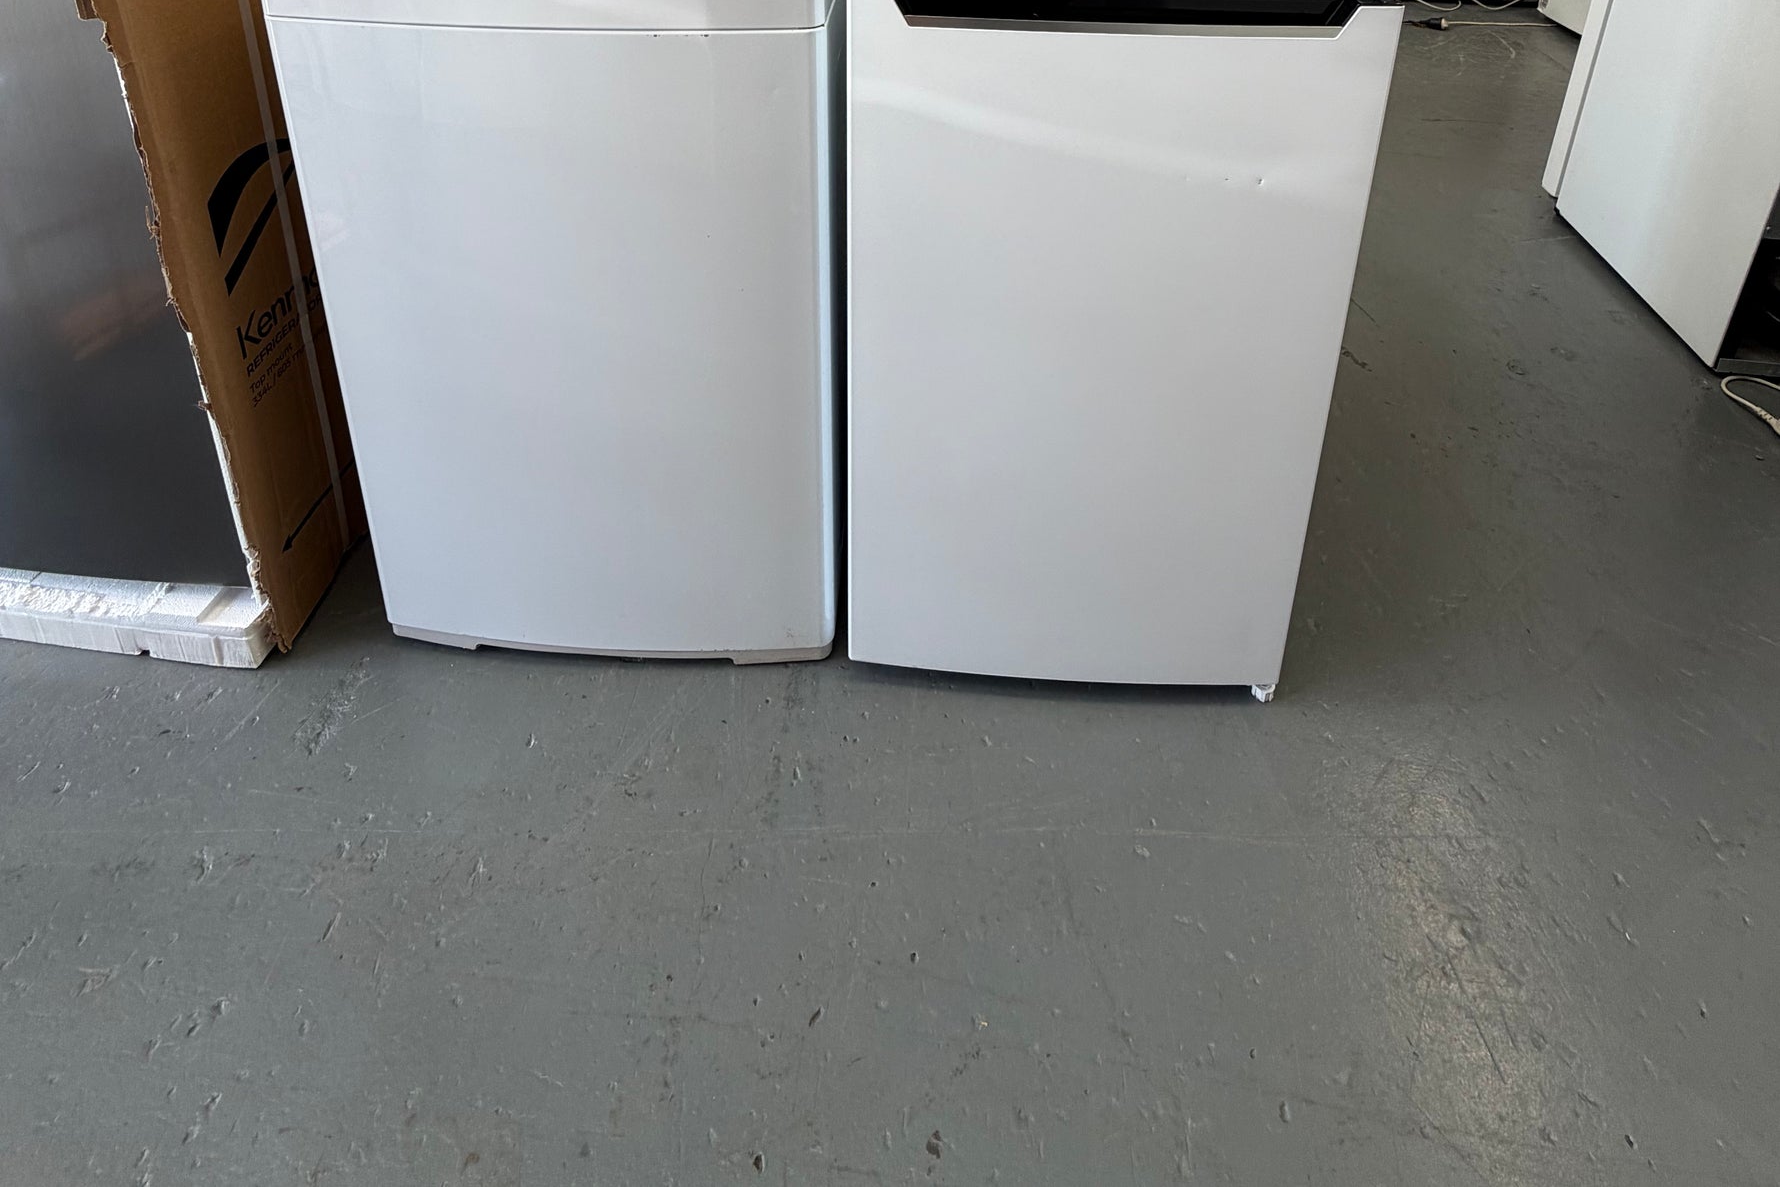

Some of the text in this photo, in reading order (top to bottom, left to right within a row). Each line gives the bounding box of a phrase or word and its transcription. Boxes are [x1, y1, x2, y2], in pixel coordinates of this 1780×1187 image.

[246, 294, 322, 377] REFRIGEROR
[249, 342, 293, 394] Top mount
